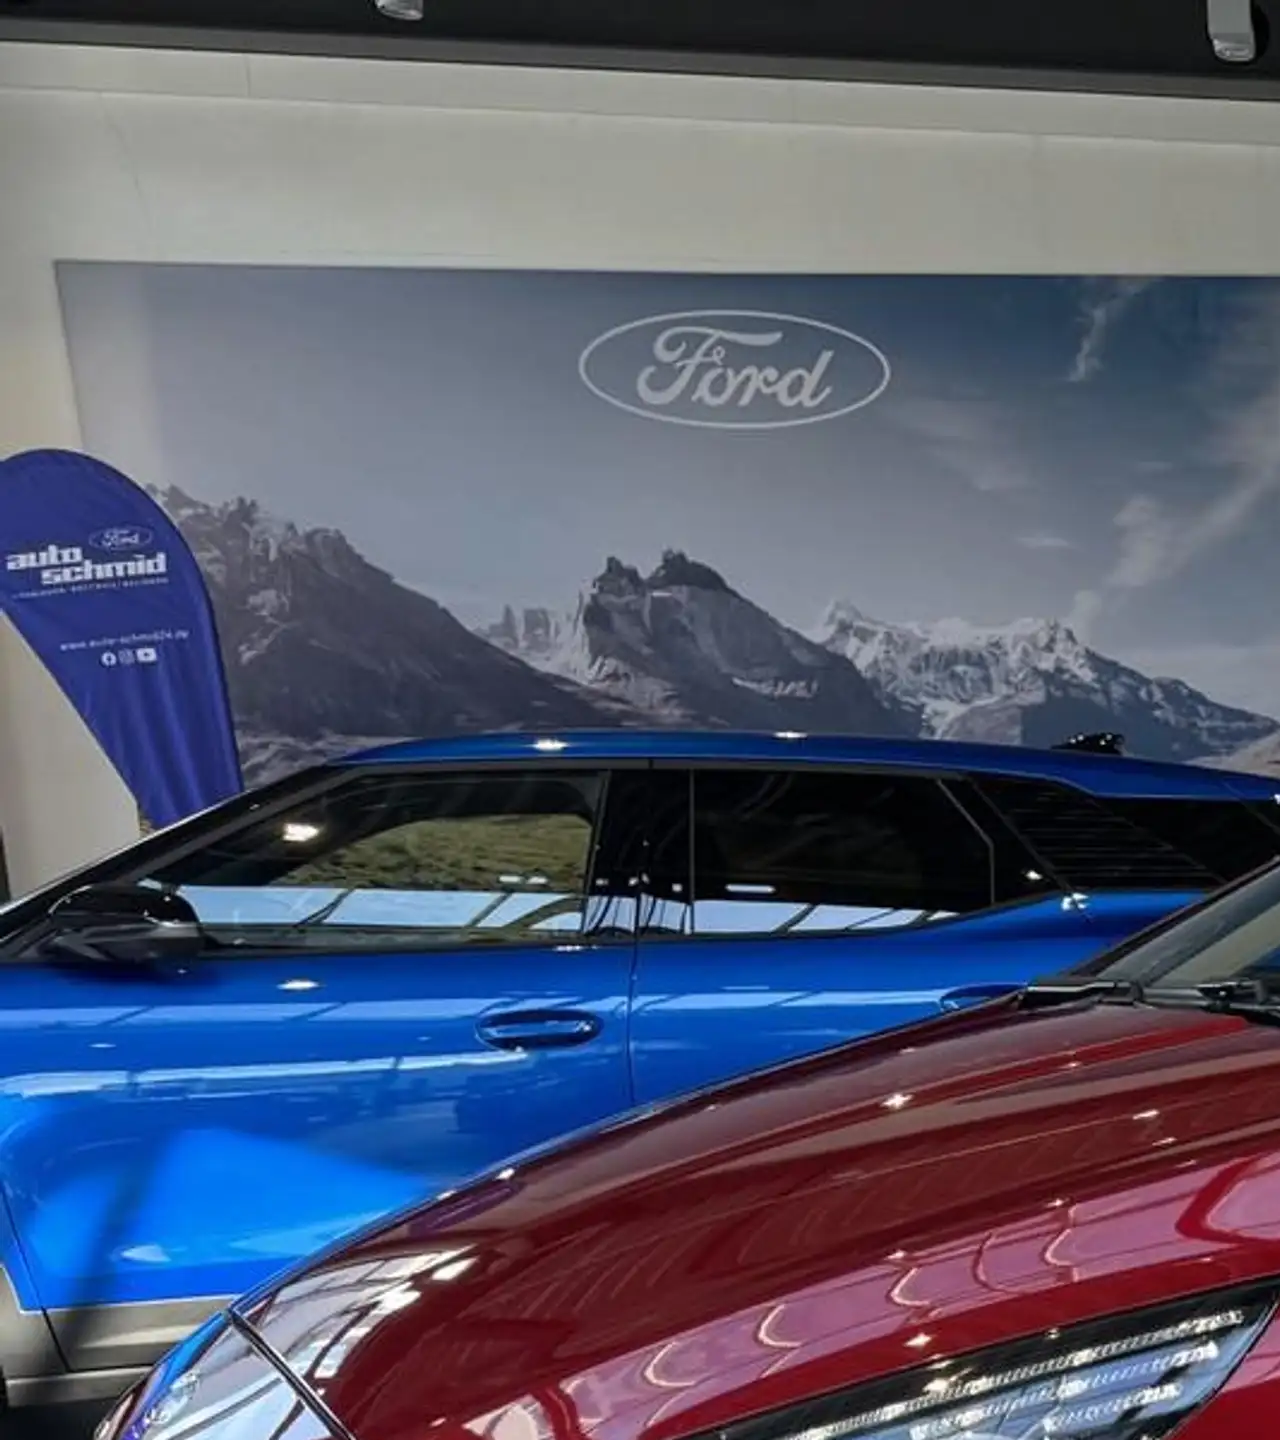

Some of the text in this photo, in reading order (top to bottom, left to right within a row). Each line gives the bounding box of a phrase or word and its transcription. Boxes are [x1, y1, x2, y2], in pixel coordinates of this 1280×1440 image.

[636, 325, 835, 408] Ford
[7, 545, 83, 570] auto
[41, 552, 168, 586] schmid
